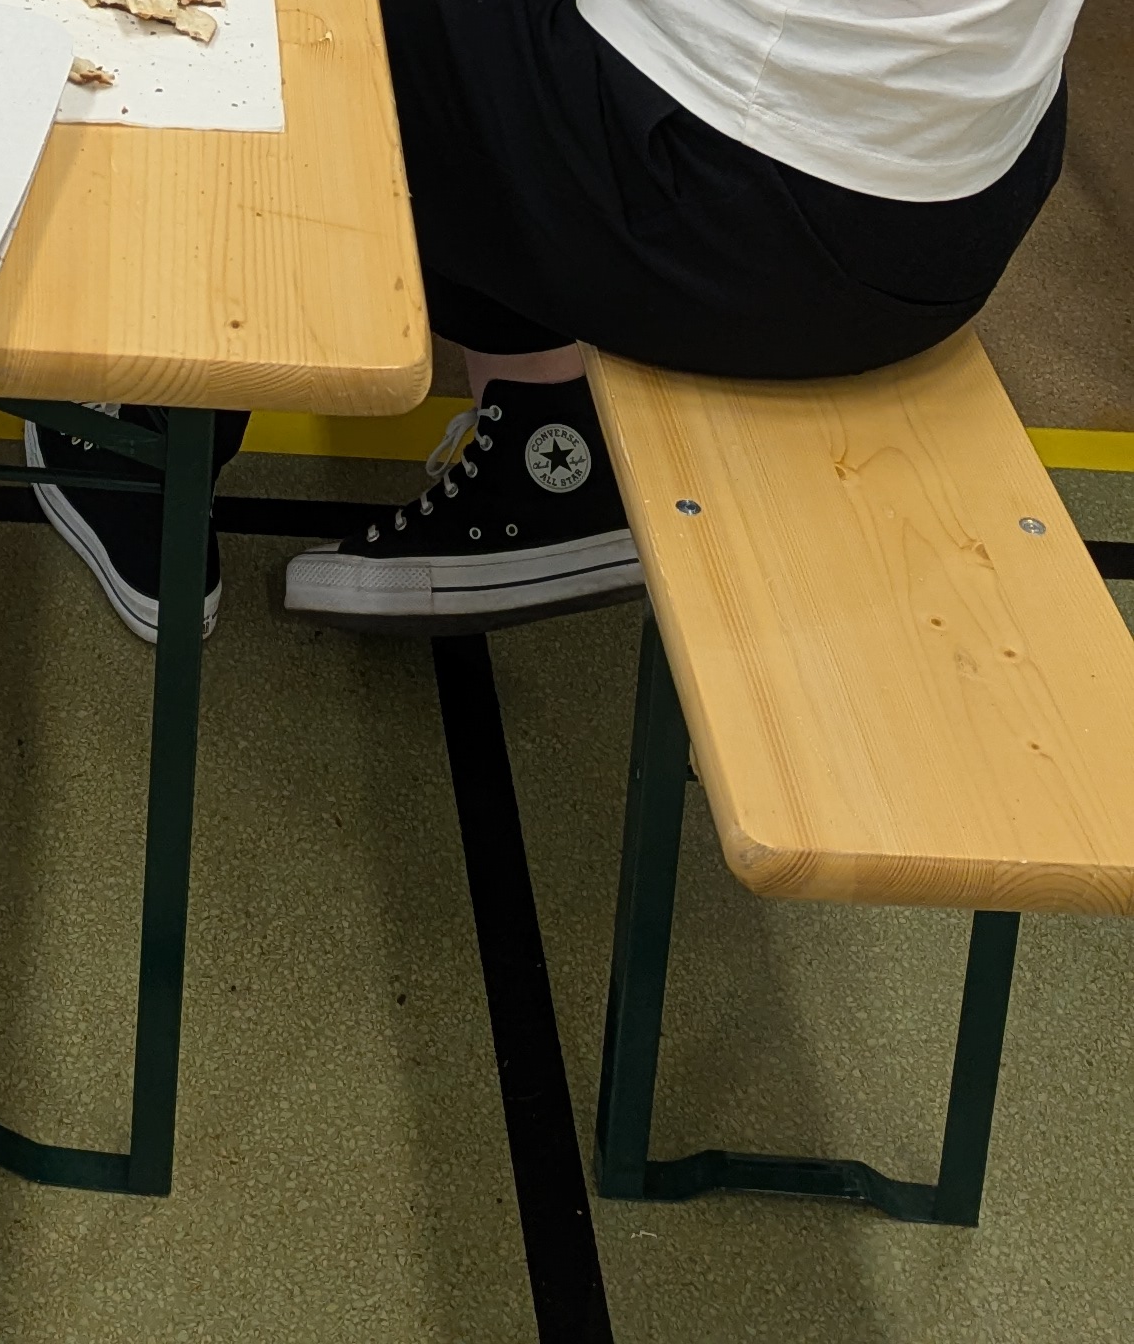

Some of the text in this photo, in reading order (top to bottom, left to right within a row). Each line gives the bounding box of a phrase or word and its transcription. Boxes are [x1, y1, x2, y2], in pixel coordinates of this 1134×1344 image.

[532, 429, 580, 453] CONVERSE
[539, 468, 583, 487] ALL STAR
